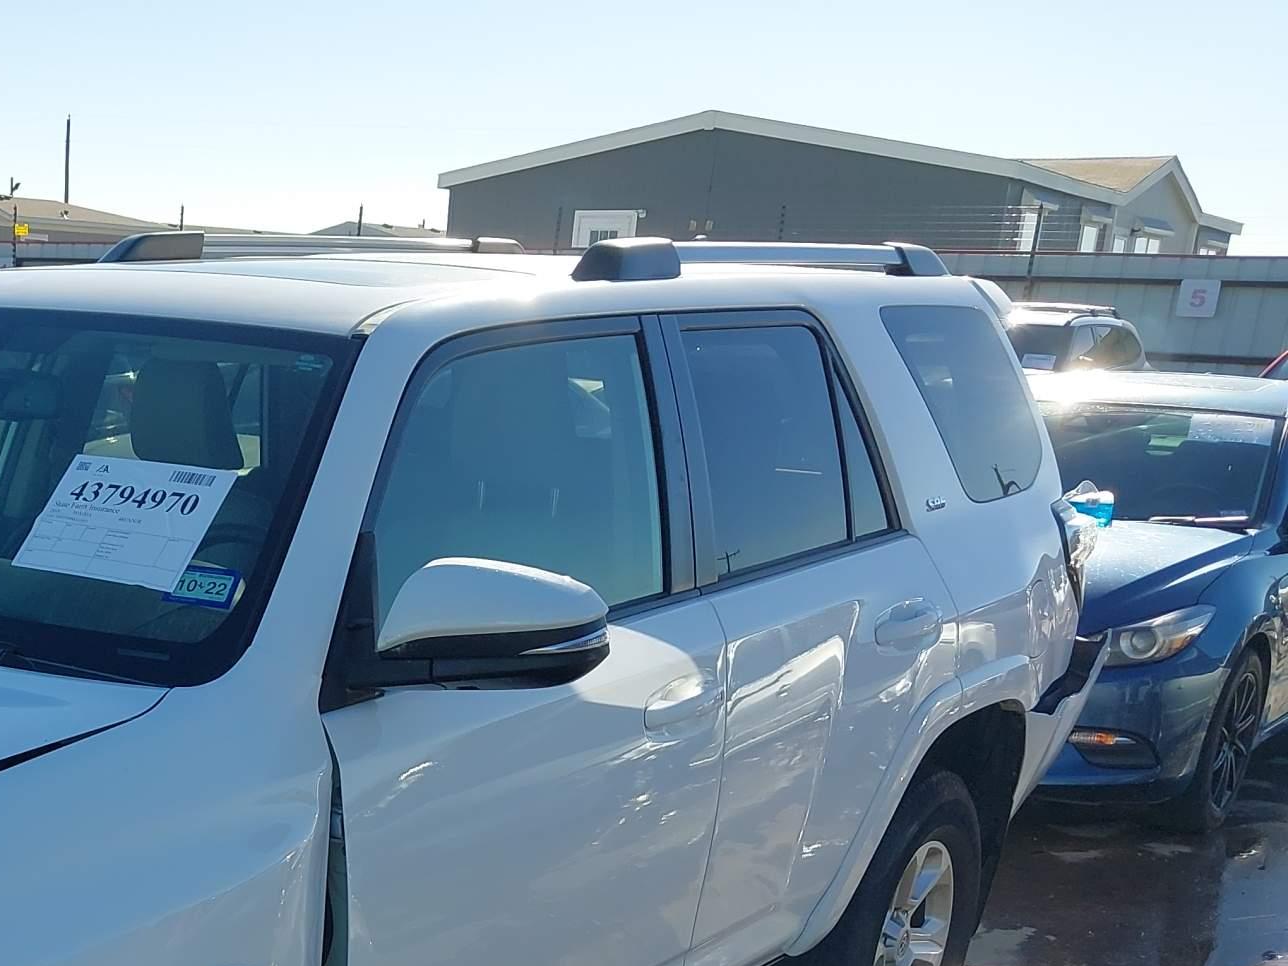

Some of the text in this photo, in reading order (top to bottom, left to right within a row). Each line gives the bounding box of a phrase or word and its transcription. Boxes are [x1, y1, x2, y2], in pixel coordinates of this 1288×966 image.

[1190, 288, 1208, 308] 5
[70, 480, 200, 516] 43794970
[204, 581, 228, 596] 22
